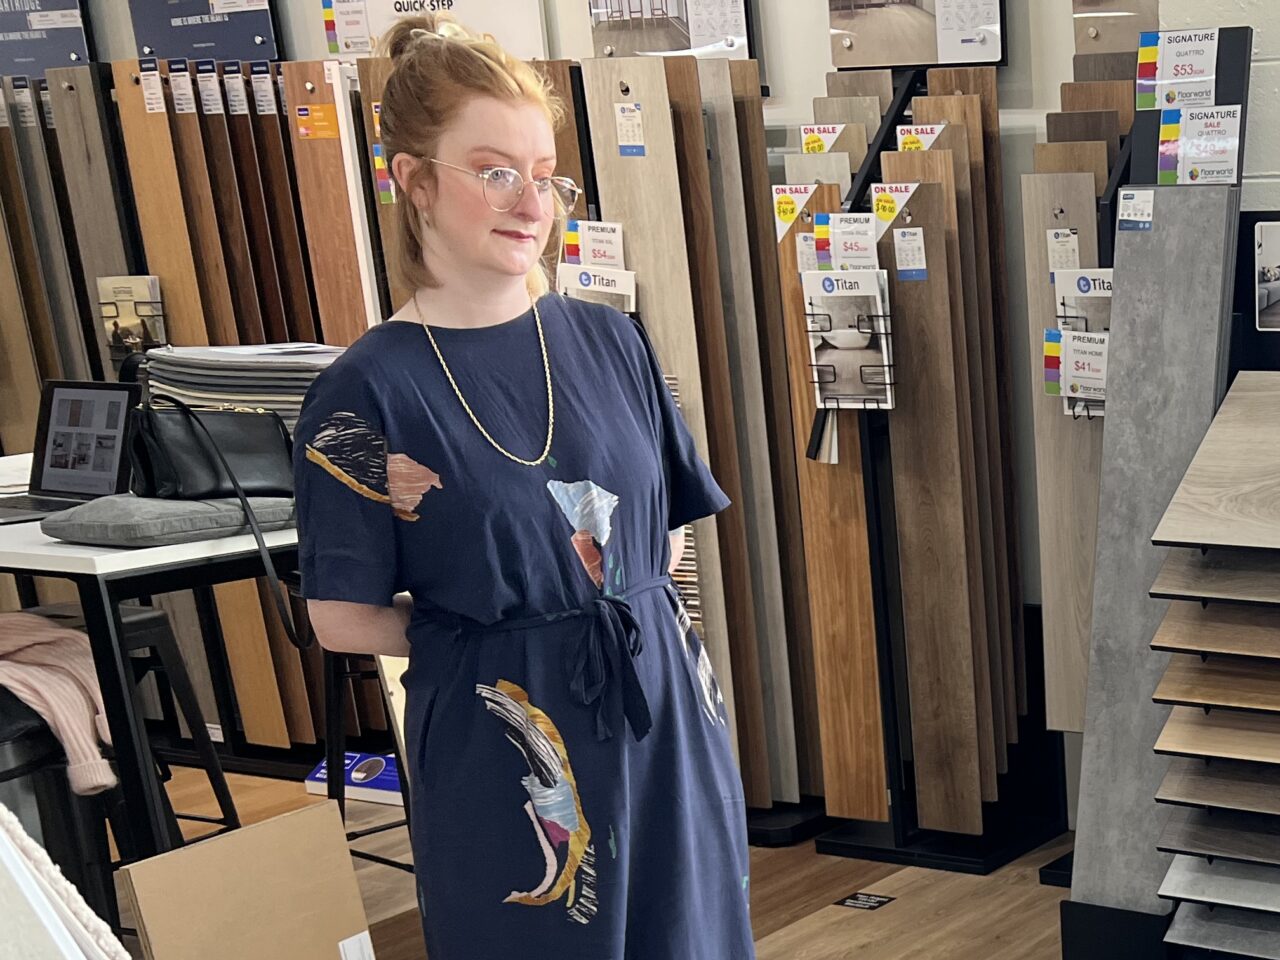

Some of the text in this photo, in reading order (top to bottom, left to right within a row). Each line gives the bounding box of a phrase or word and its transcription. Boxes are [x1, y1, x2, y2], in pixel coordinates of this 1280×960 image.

[1167, 32, 1215, 44] SIGNATURE
[1189, 110, 1238, 120] SIGNATURE
[816, 126, 837, 134] SALE
[916, 127, 935, 135] SALE
[1197, 129, 1227, 137] QUATTRO
[789, 186, 810, 194] SALE
[889, 185, 910, 193] SALE
[588, 225, 616, 233] PREMIUM
[592, 275, 616, 287] Titan
[834, 279, 860, 290] Titan
[1072, 335, 1106, 345] PREMIUM
